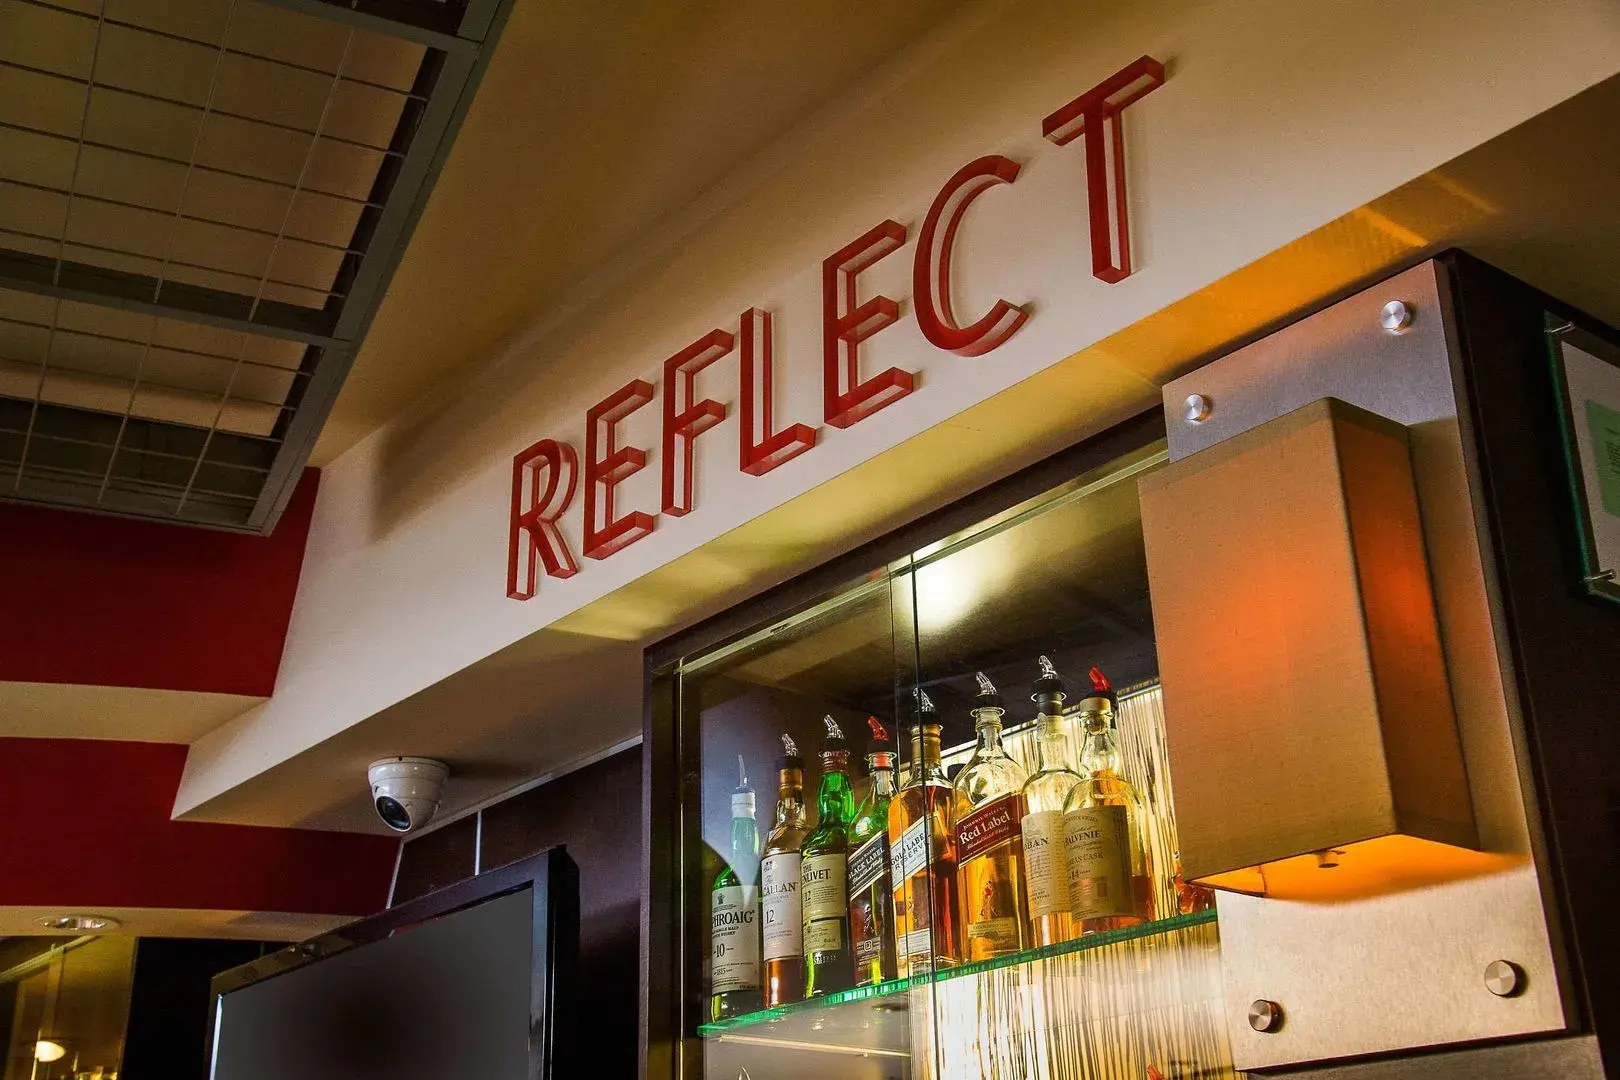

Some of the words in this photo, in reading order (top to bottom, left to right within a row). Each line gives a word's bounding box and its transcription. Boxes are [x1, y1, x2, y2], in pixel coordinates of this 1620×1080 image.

[506, 55, 1166, 601] REFLECT
[960, 825, 981, 844] Red
[981, 811, 1010, 832] Label
[894, 842, 925, 870] RESERV
[907, 833, 925, 851] LABE
[766, 909, 774, 924] 12
